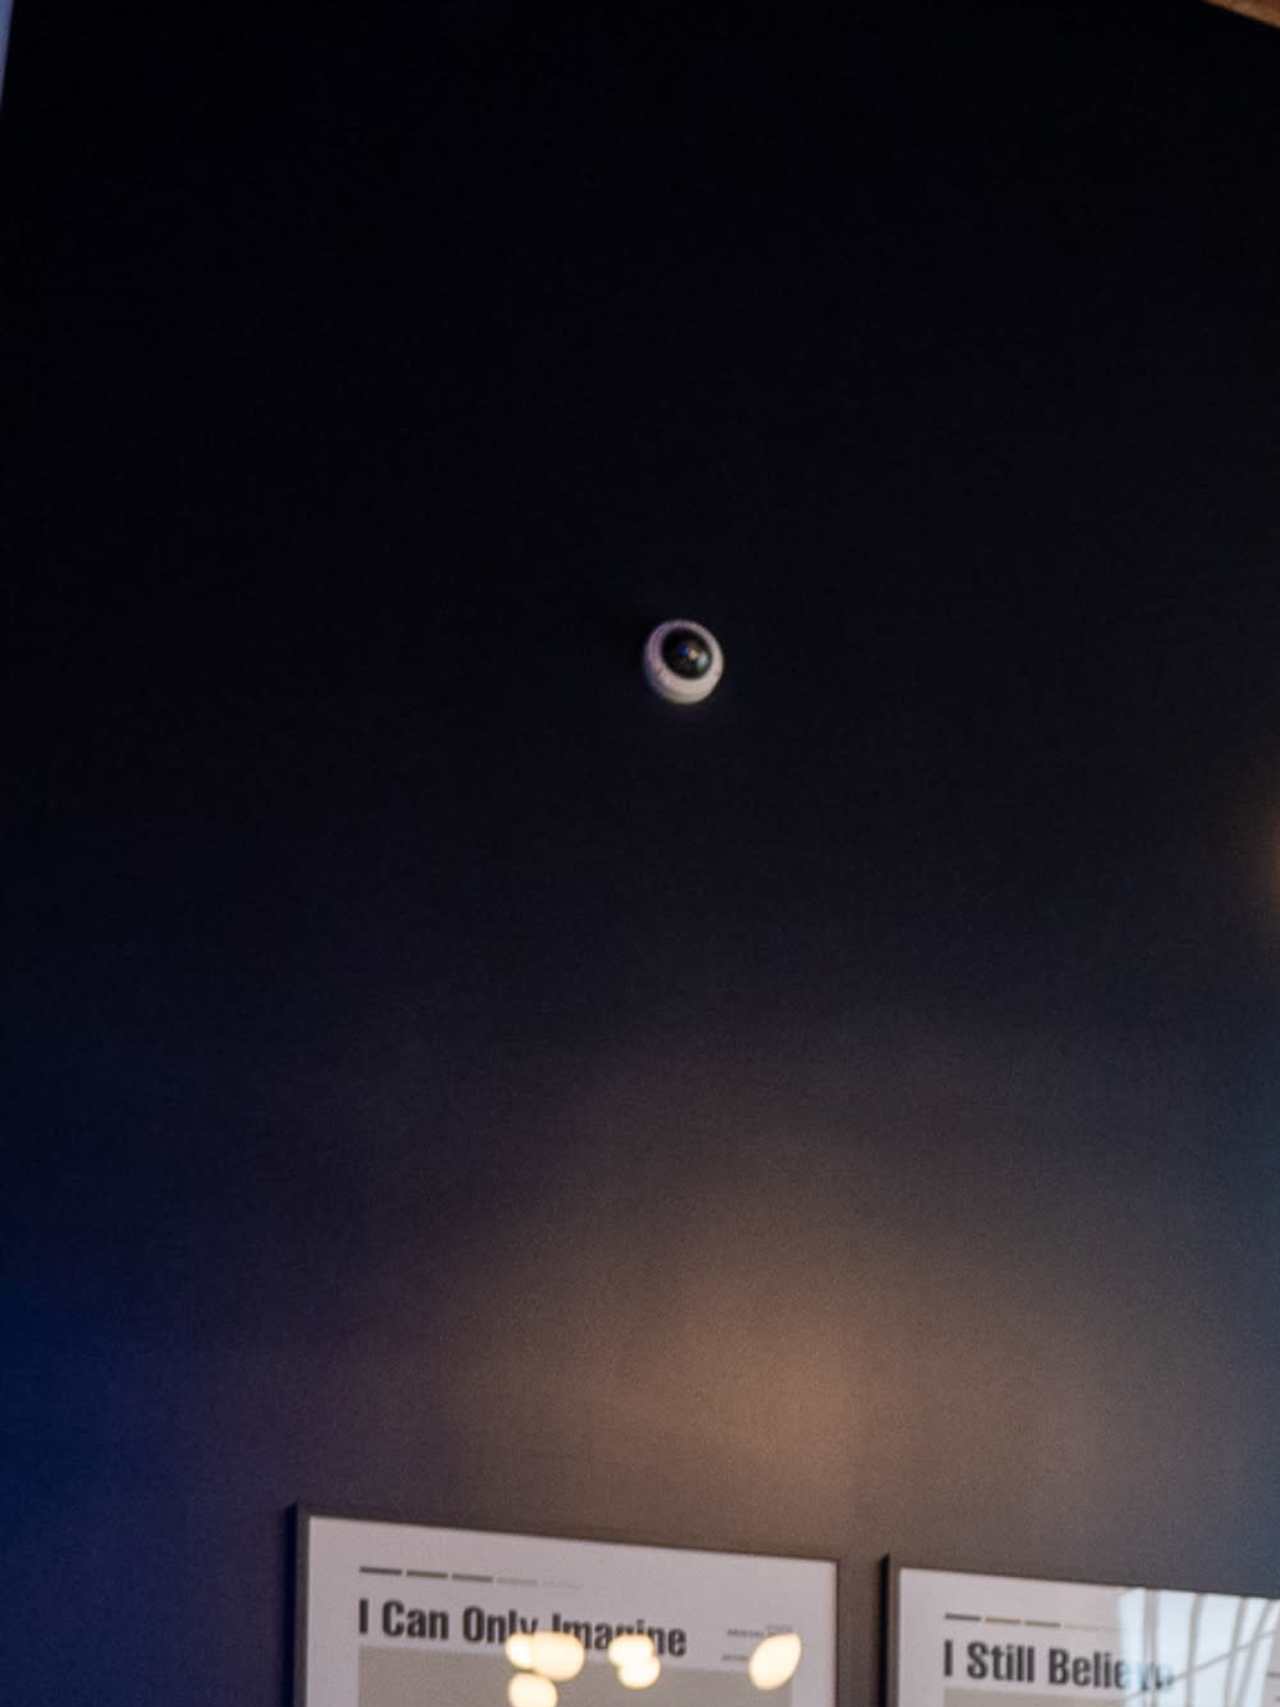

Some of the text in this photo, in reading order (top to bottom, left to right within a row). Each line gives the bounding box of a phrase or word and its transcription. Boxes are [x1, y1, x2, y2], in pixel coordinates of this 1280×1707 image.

[358, 1598, 369, 1635] I
[381, 1600, 450, 1641] Can
[552, 1612, 687, 1657] Imane
[943, 1638, 954, 1677] I
[966, 1640, 1035, 1684] Still
